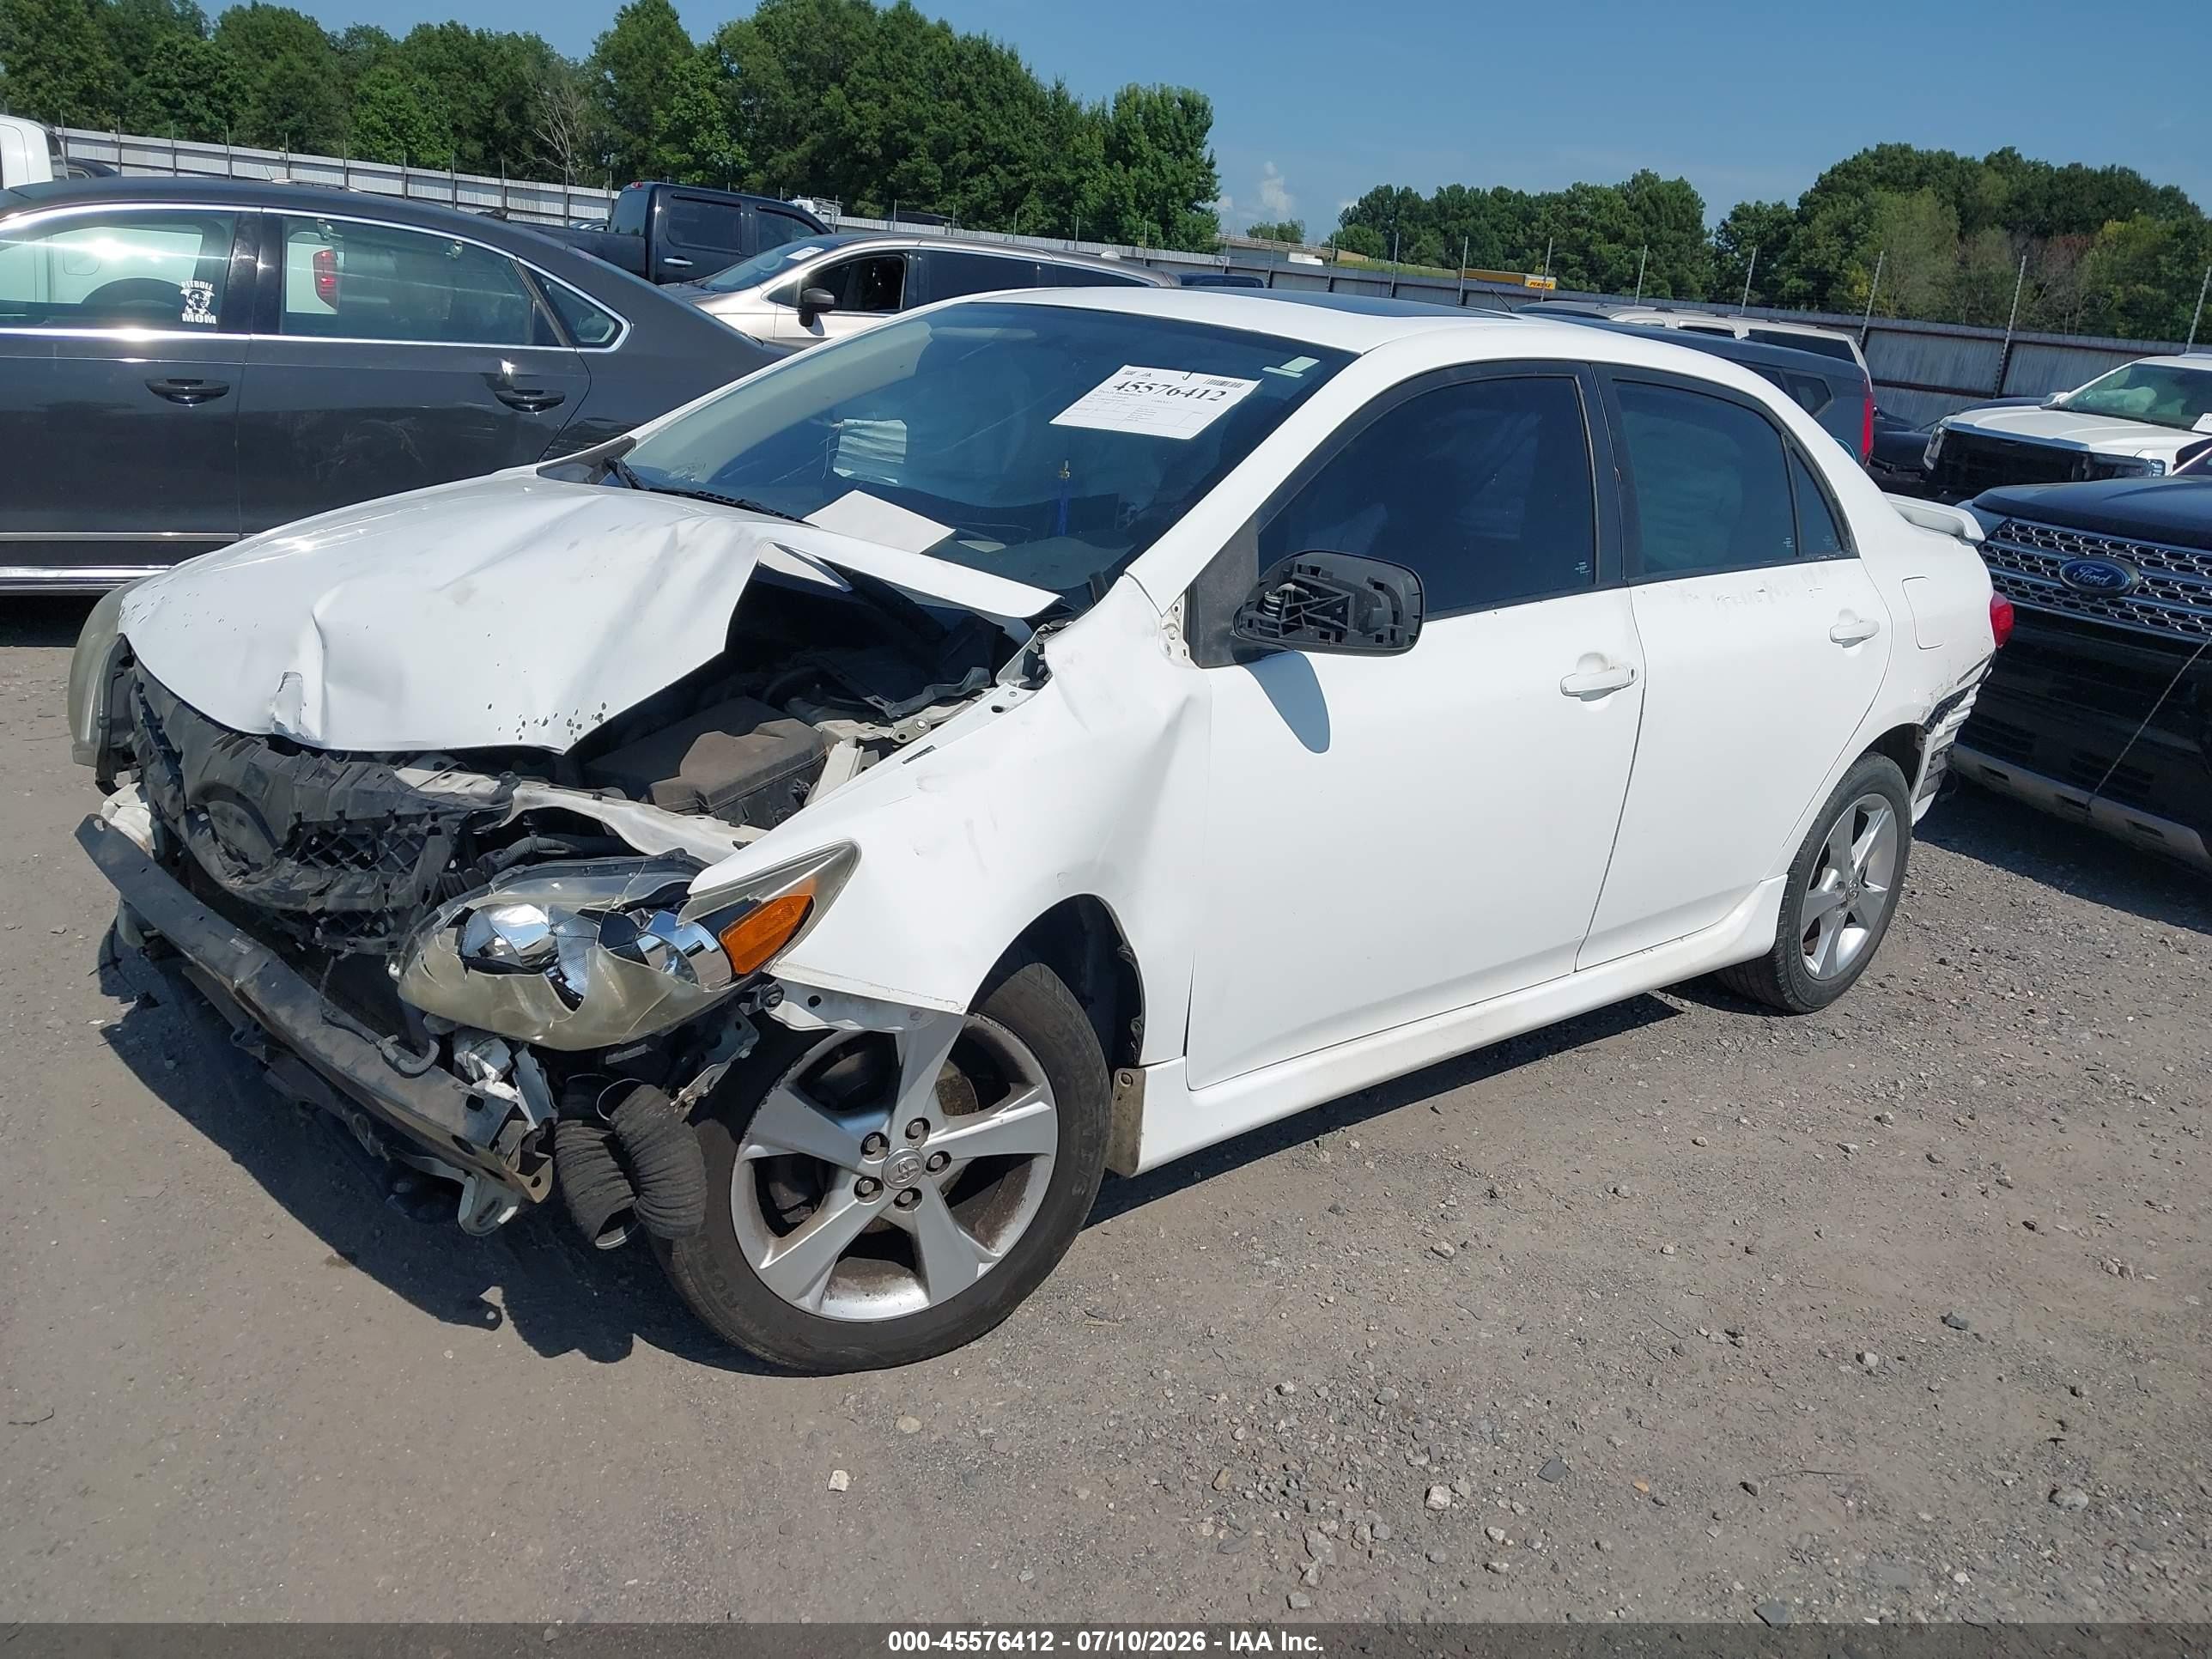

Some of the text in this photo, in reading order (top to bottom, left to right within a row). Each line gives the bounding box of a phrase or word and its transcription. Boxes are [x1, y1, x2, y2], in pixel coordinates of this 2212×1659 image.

[180, 280, 213, 291] PITBULL
[181, 313, 216, 324] MOM
[1113, 380, 1228, 402] 45576412
[2072, 565, 2113, 586] Ford
